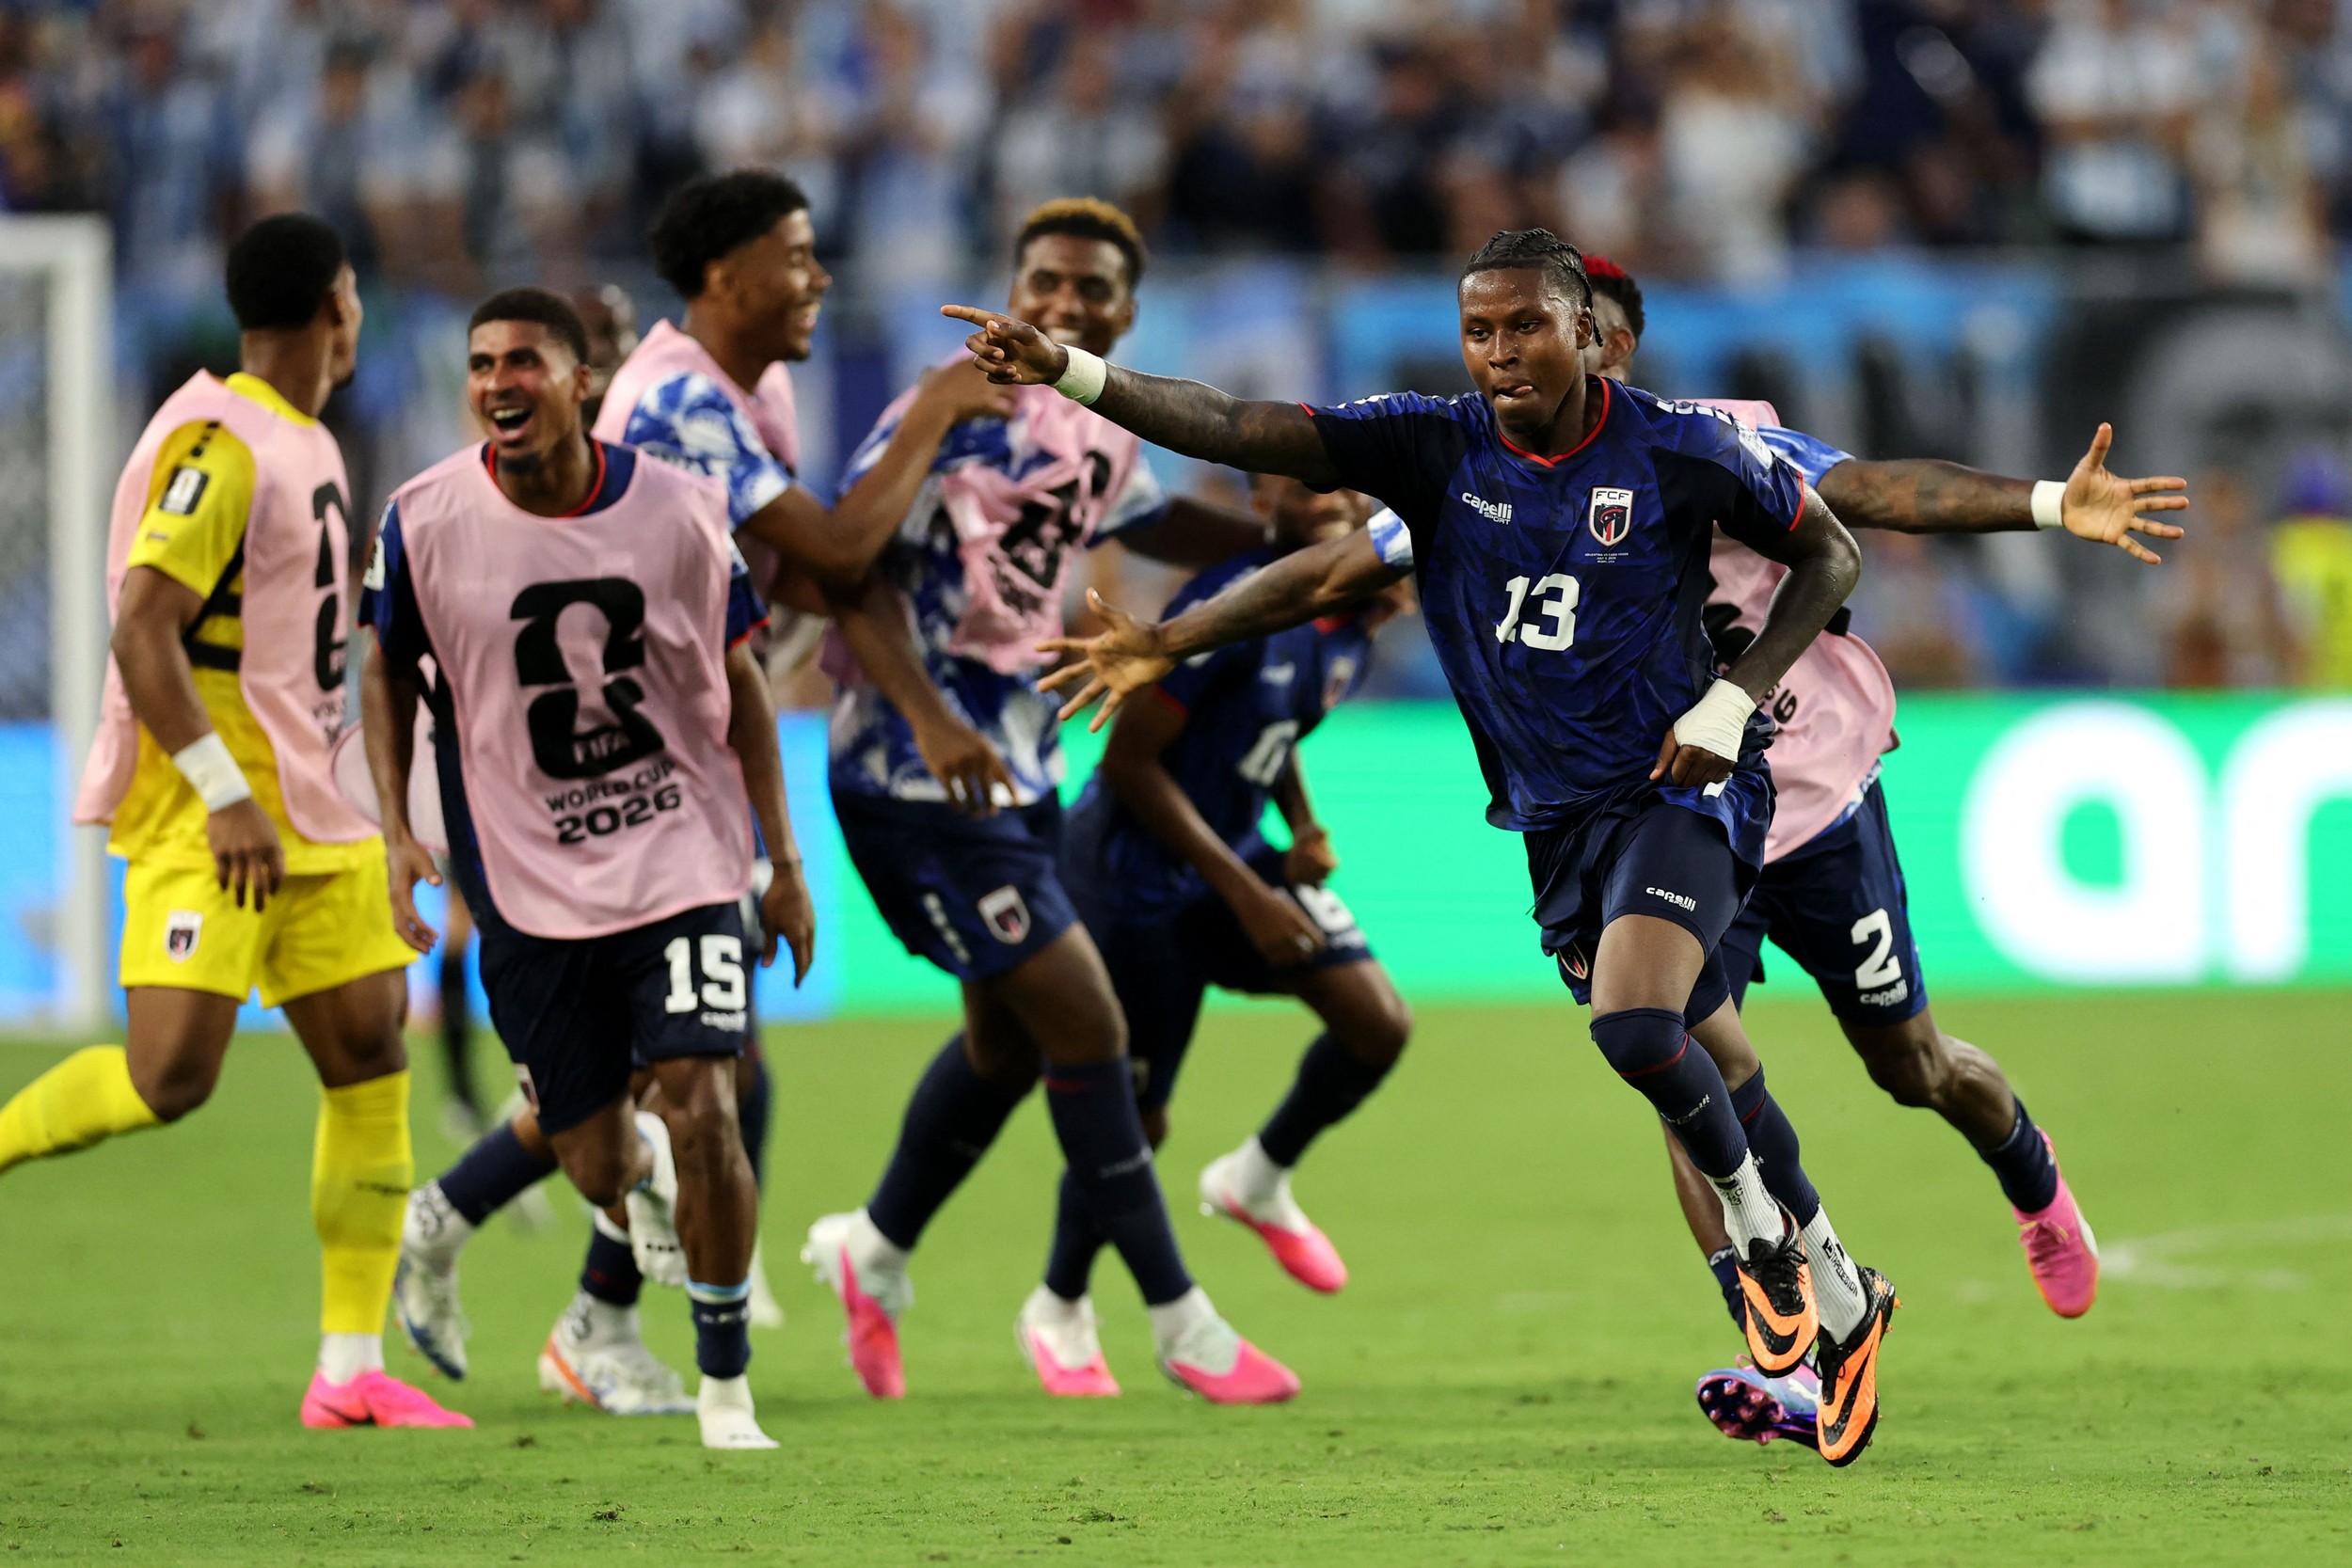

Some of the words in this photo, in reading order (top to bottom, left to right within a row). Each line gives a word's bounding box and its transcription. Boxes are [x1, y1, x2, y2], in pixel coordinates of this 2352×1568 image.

[1461, 492, 1513, 519] capelli
[1484, 511, 1512, 526] SPORT
[1596, 490, 1629, 500] FCF
[1495, 572, 1581, 652] 13
[546, 780, 630, 813] WORLD
[634, 757, 675, 790] CUP
[555, 783, 681, 845] 2026
[1645, 886, 1697, 911] capelli
[663, 934, 746, 1013] 15
[1851, 908, 1902, 990] 2
